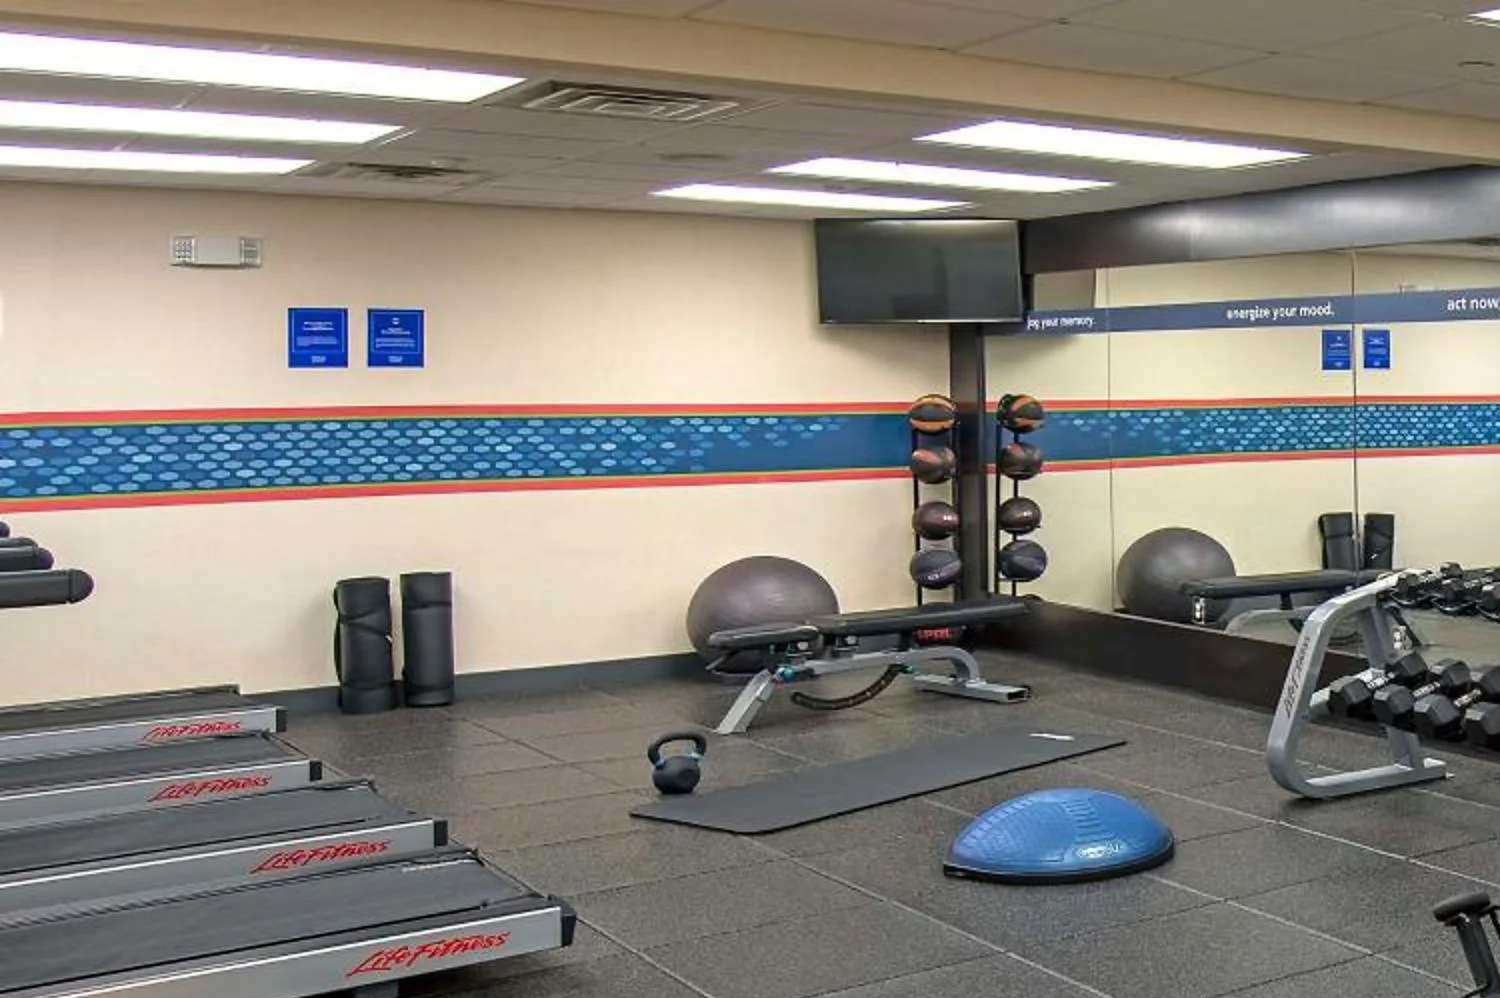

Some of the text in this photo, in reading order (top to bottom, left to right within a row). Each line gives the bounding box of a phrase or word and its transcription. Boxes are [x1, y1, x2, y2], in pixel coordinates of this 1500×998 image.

[1226, 301, 1335, 321] energize your mood.
[1447, 297, 1467, 311] act
